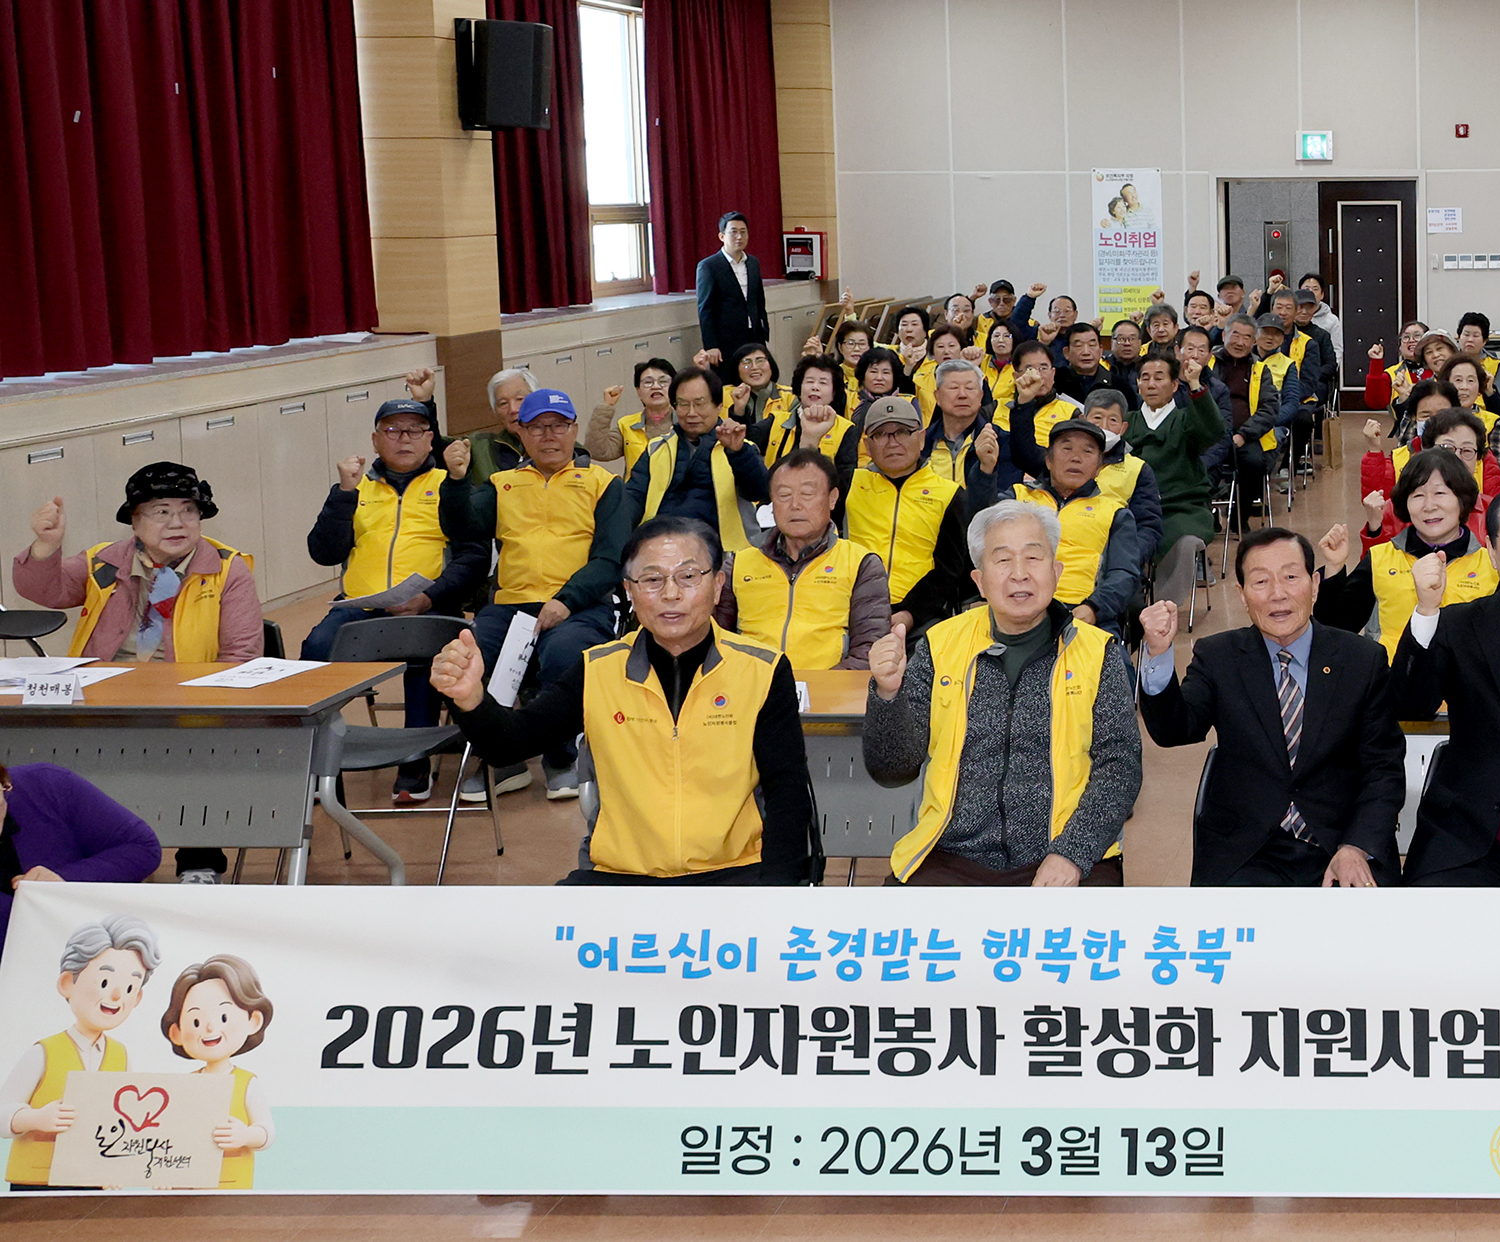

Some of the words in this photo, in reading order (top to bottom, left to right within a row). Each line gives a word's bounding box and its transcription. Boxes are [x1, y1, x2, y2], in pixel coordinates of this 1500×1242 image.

[1098, 231, 1156, 248] 노인취업
[27, 683, 72, 696] 청천매봉
[780, 926, 962, 982] 존경받는
[982, 927, 1127, 985] 행복한
[320, 1002, 594, 1076] 2026년
[609, 1003, 1006, 1078] 노인자원봉사
[1023, 1005, 1222, 1079] 활성화
[681, 1125, 773, 1176] 일정
[819, 1126, 1002, 1176] 2026년
[1020, 1126, 1101, 1177] 3월
[1121, 1127, 1225, 1178] 13일
